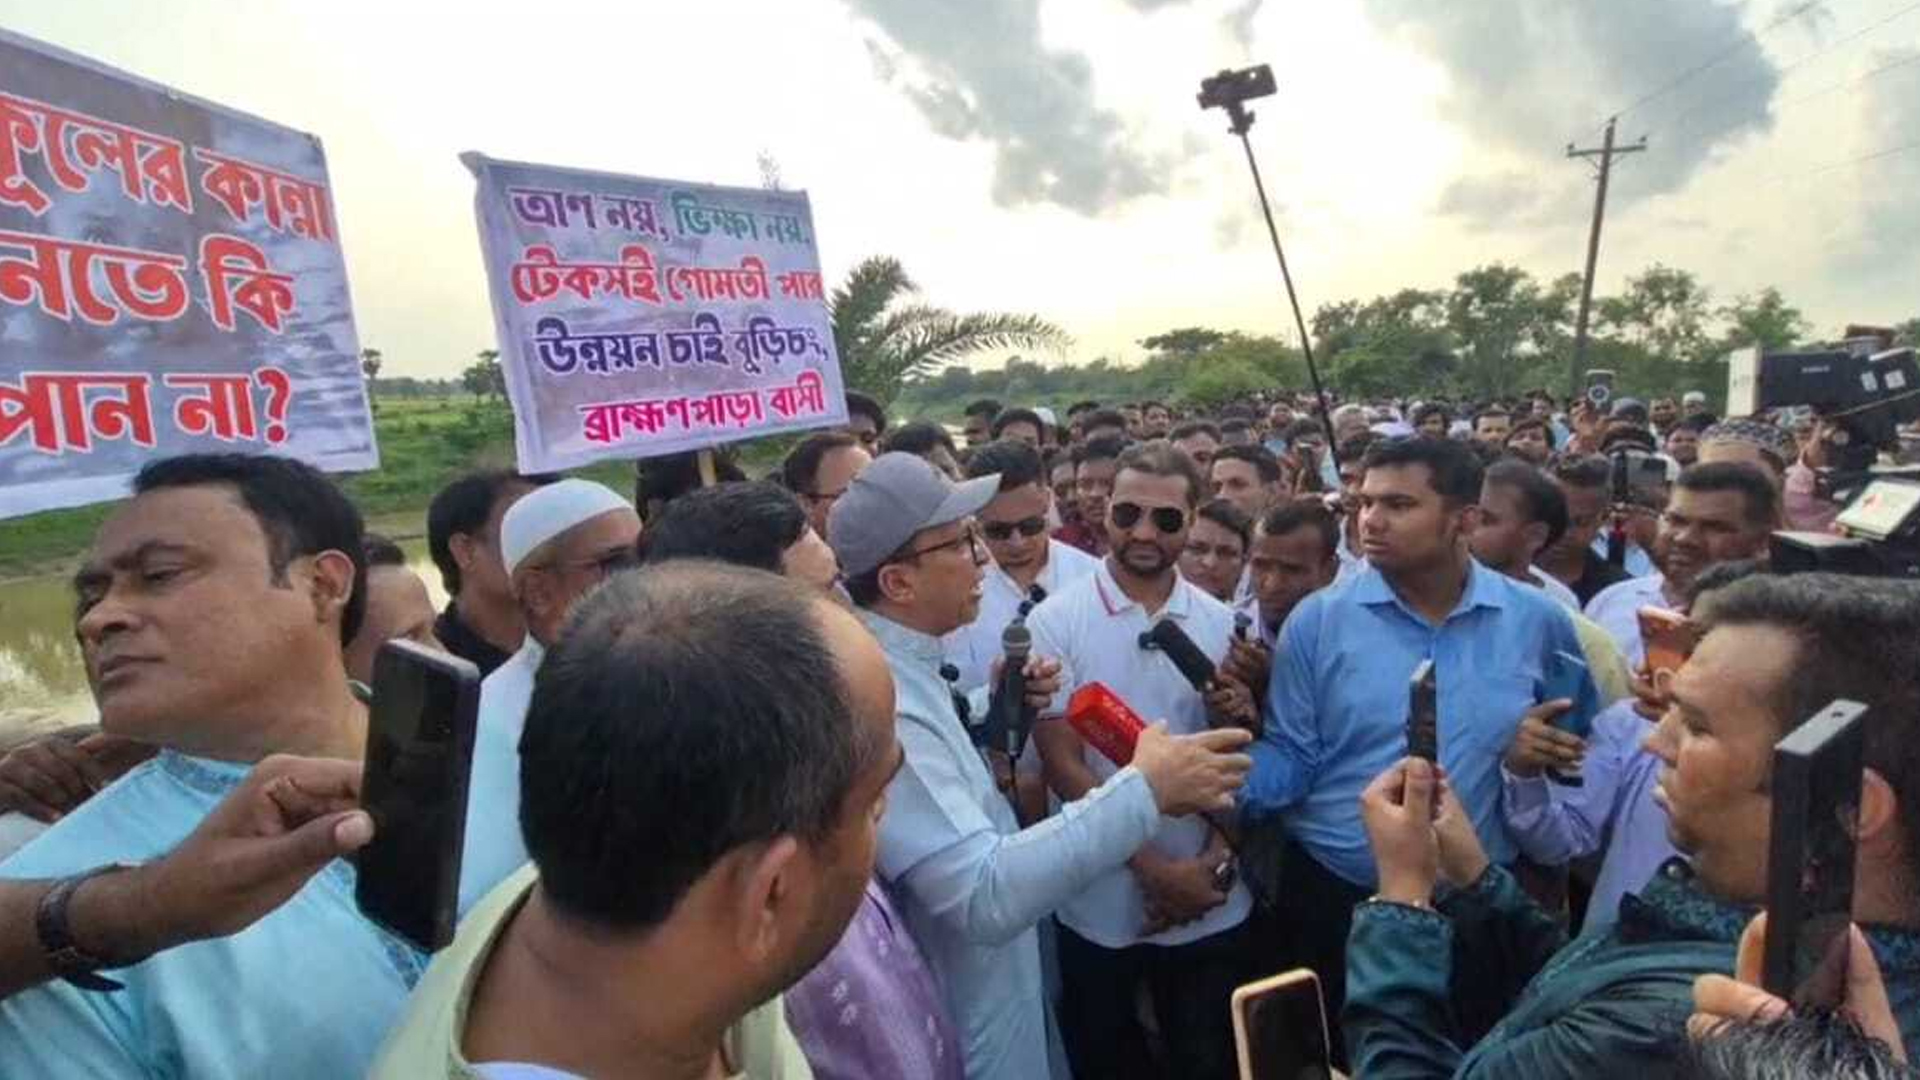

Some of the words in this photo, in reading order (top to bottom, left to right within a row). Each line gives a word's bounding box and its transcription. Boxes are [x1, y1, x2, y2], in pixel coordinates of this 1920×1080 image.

[193, 147, 333, 242] কান্না
[508, 187, 597, 229] ত্রাণ
[602, 195, 669, 241] নয়,
[671, 191, 758, 241] ভিক্ষা
[199, 235, 294, 333] কি
[511, 246, 662, 306] টেকসই
[666, 255, 770, 301] গোমতী
[536, 316, 661, 373] উন্নয়ন
[666, 312, 729, 366] চাই
[730, 316, 829, 374] বুড়িচং,
[162, 366, 291, 448] না?
[767, 370, 824, 416] বাসী
